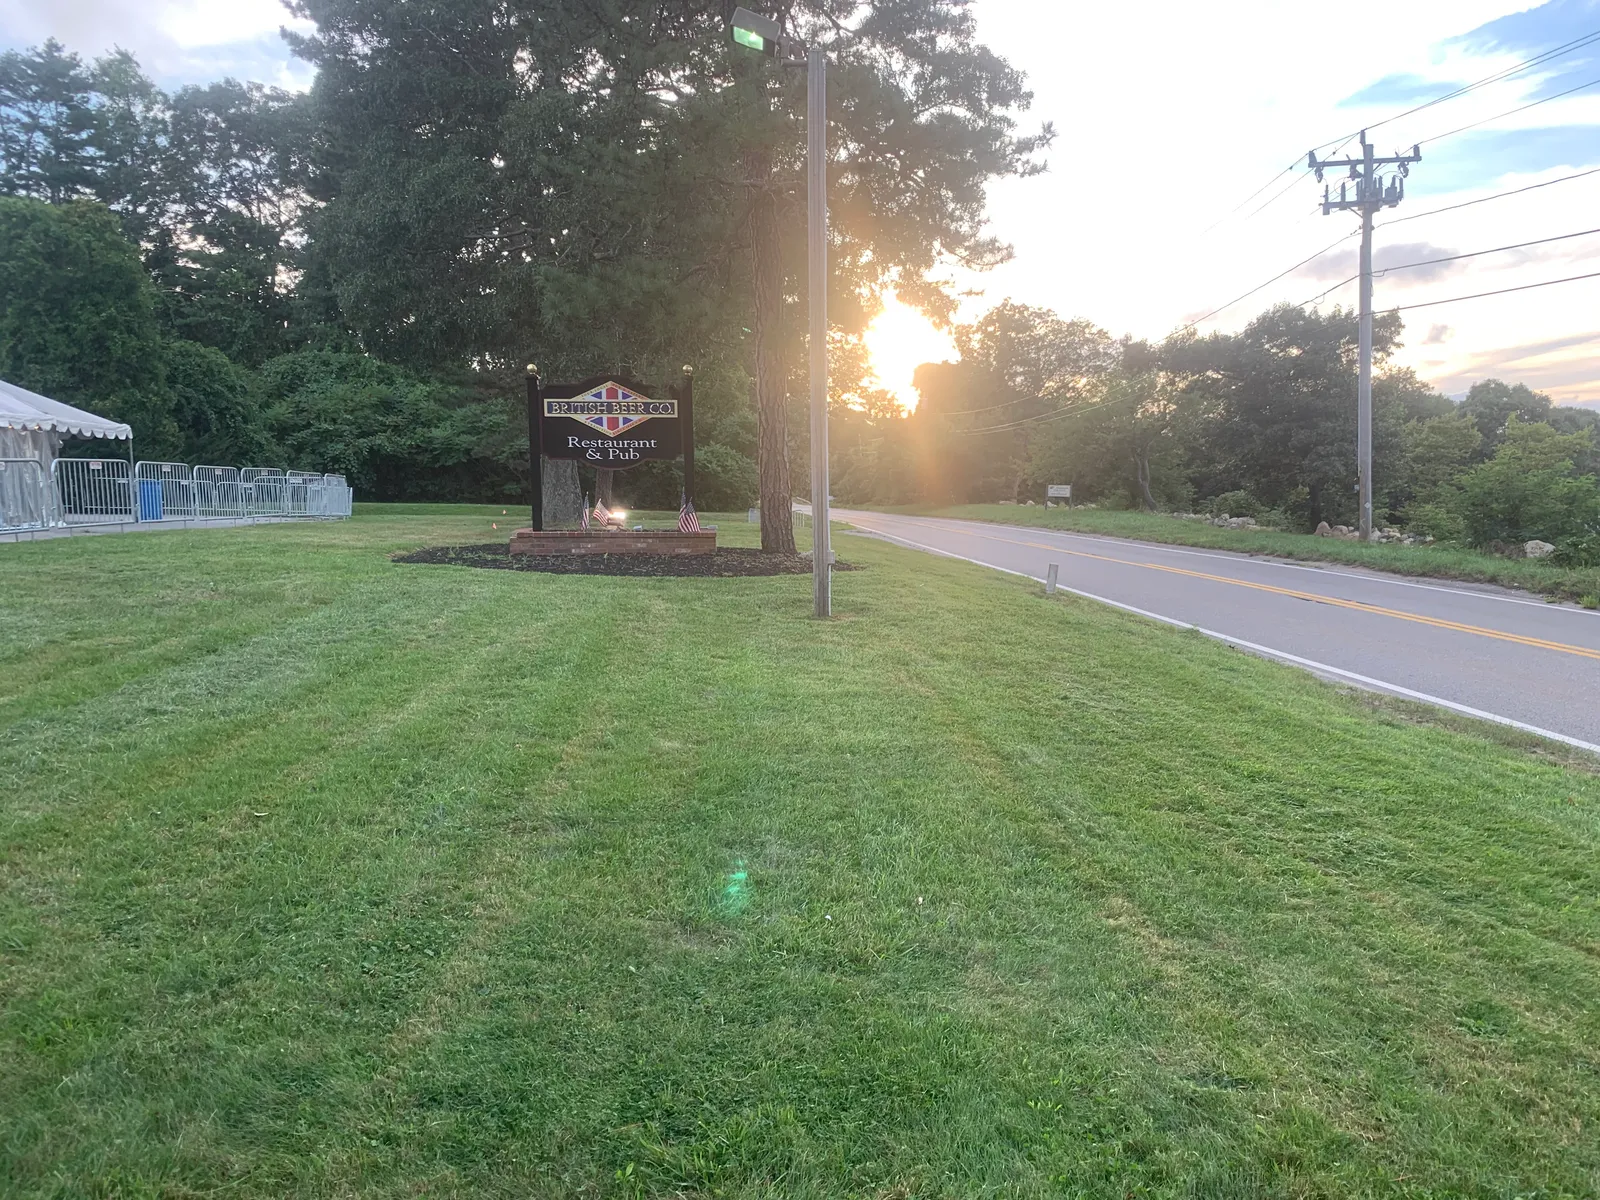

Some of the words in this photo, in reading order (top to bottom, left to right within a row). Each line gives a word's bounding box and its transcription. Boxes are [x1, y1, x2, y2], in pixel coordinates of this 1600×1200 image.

[551, 402, 608, 414] BRITISH
[611, 402, 647, 414] BEER
[567, 436, 657, 448] Restaurant
[585, 448, 603, 460] &
[608, 448, 640, 460] Pub
